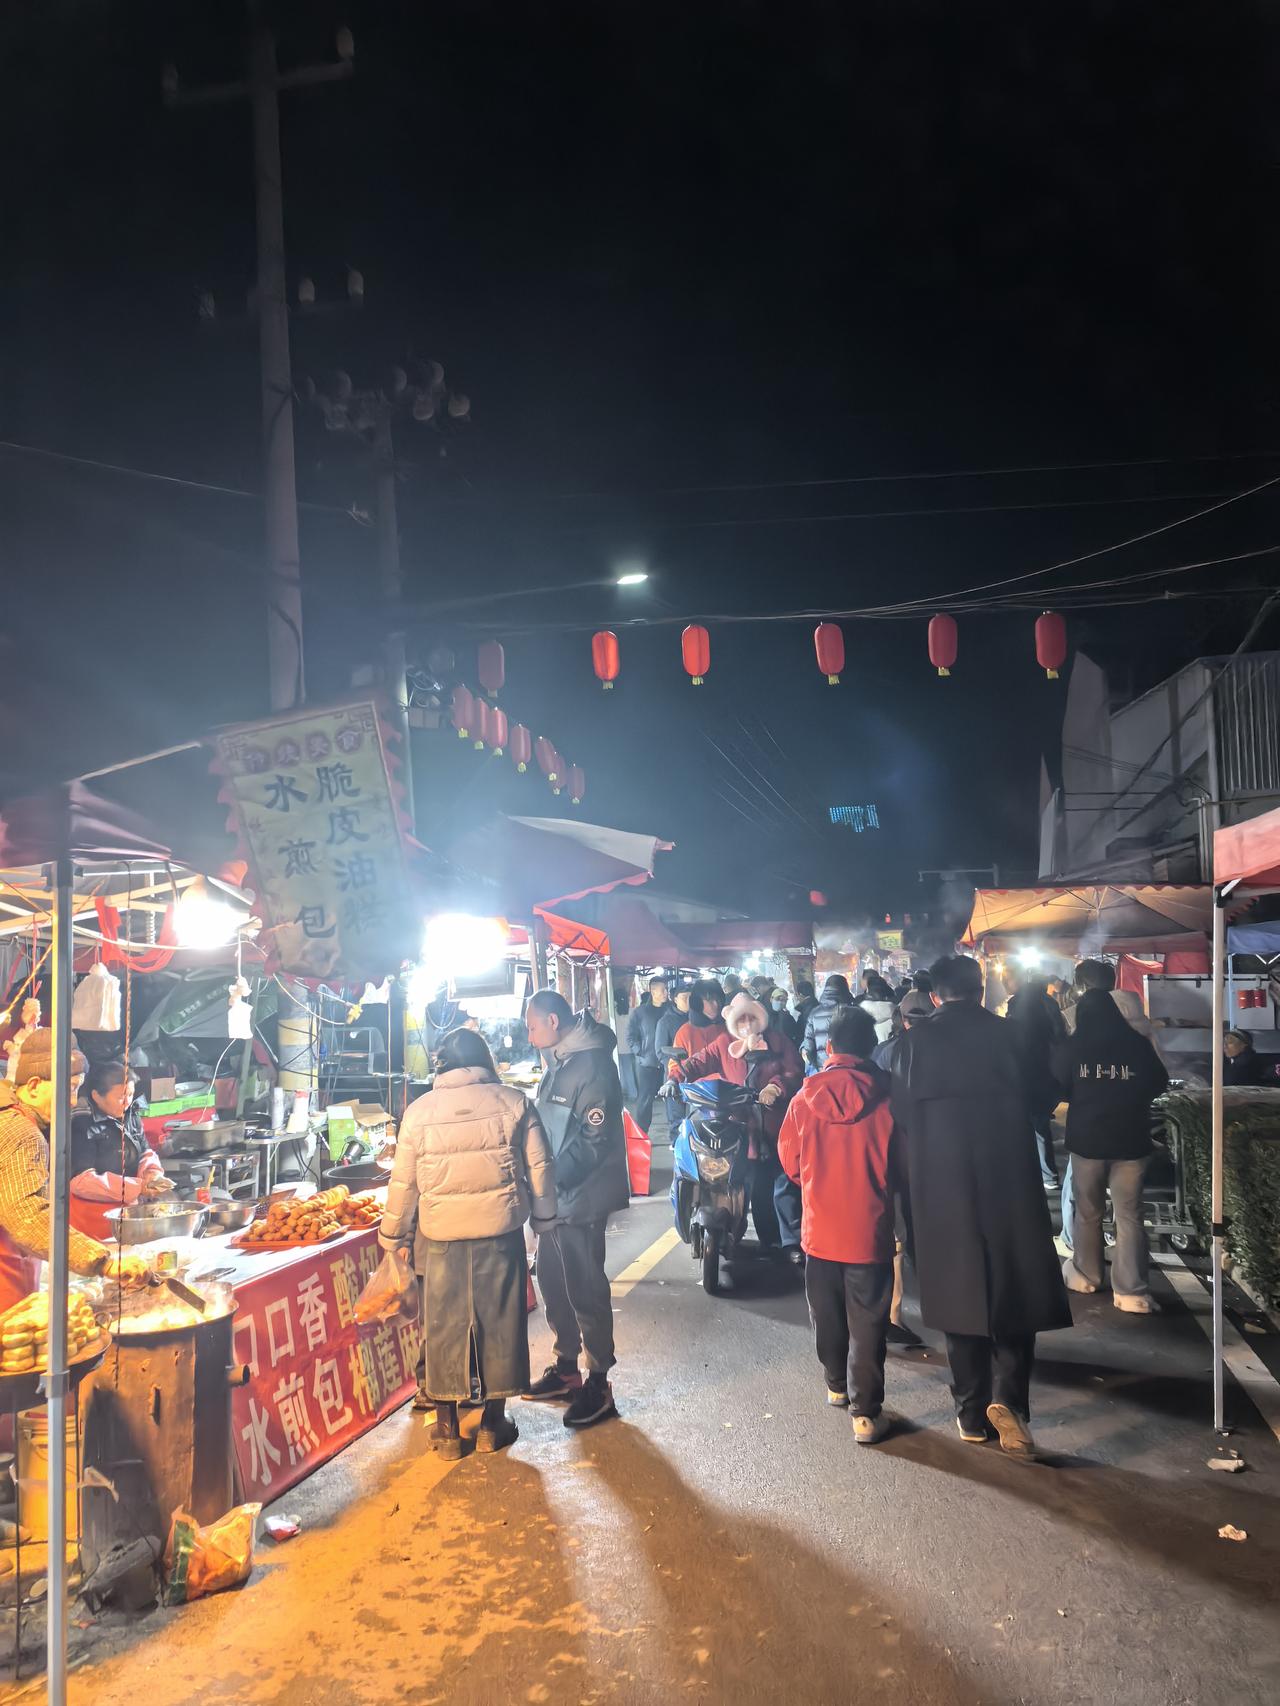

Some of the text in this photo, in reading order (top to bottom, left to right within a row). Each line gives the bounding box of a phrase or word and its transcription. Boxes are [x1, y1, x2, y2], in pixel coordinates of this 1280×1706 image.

[264, 774, 336, 939] 水煎包
[241, 1322, 421, 1486] 水煎包 榴莲麻
